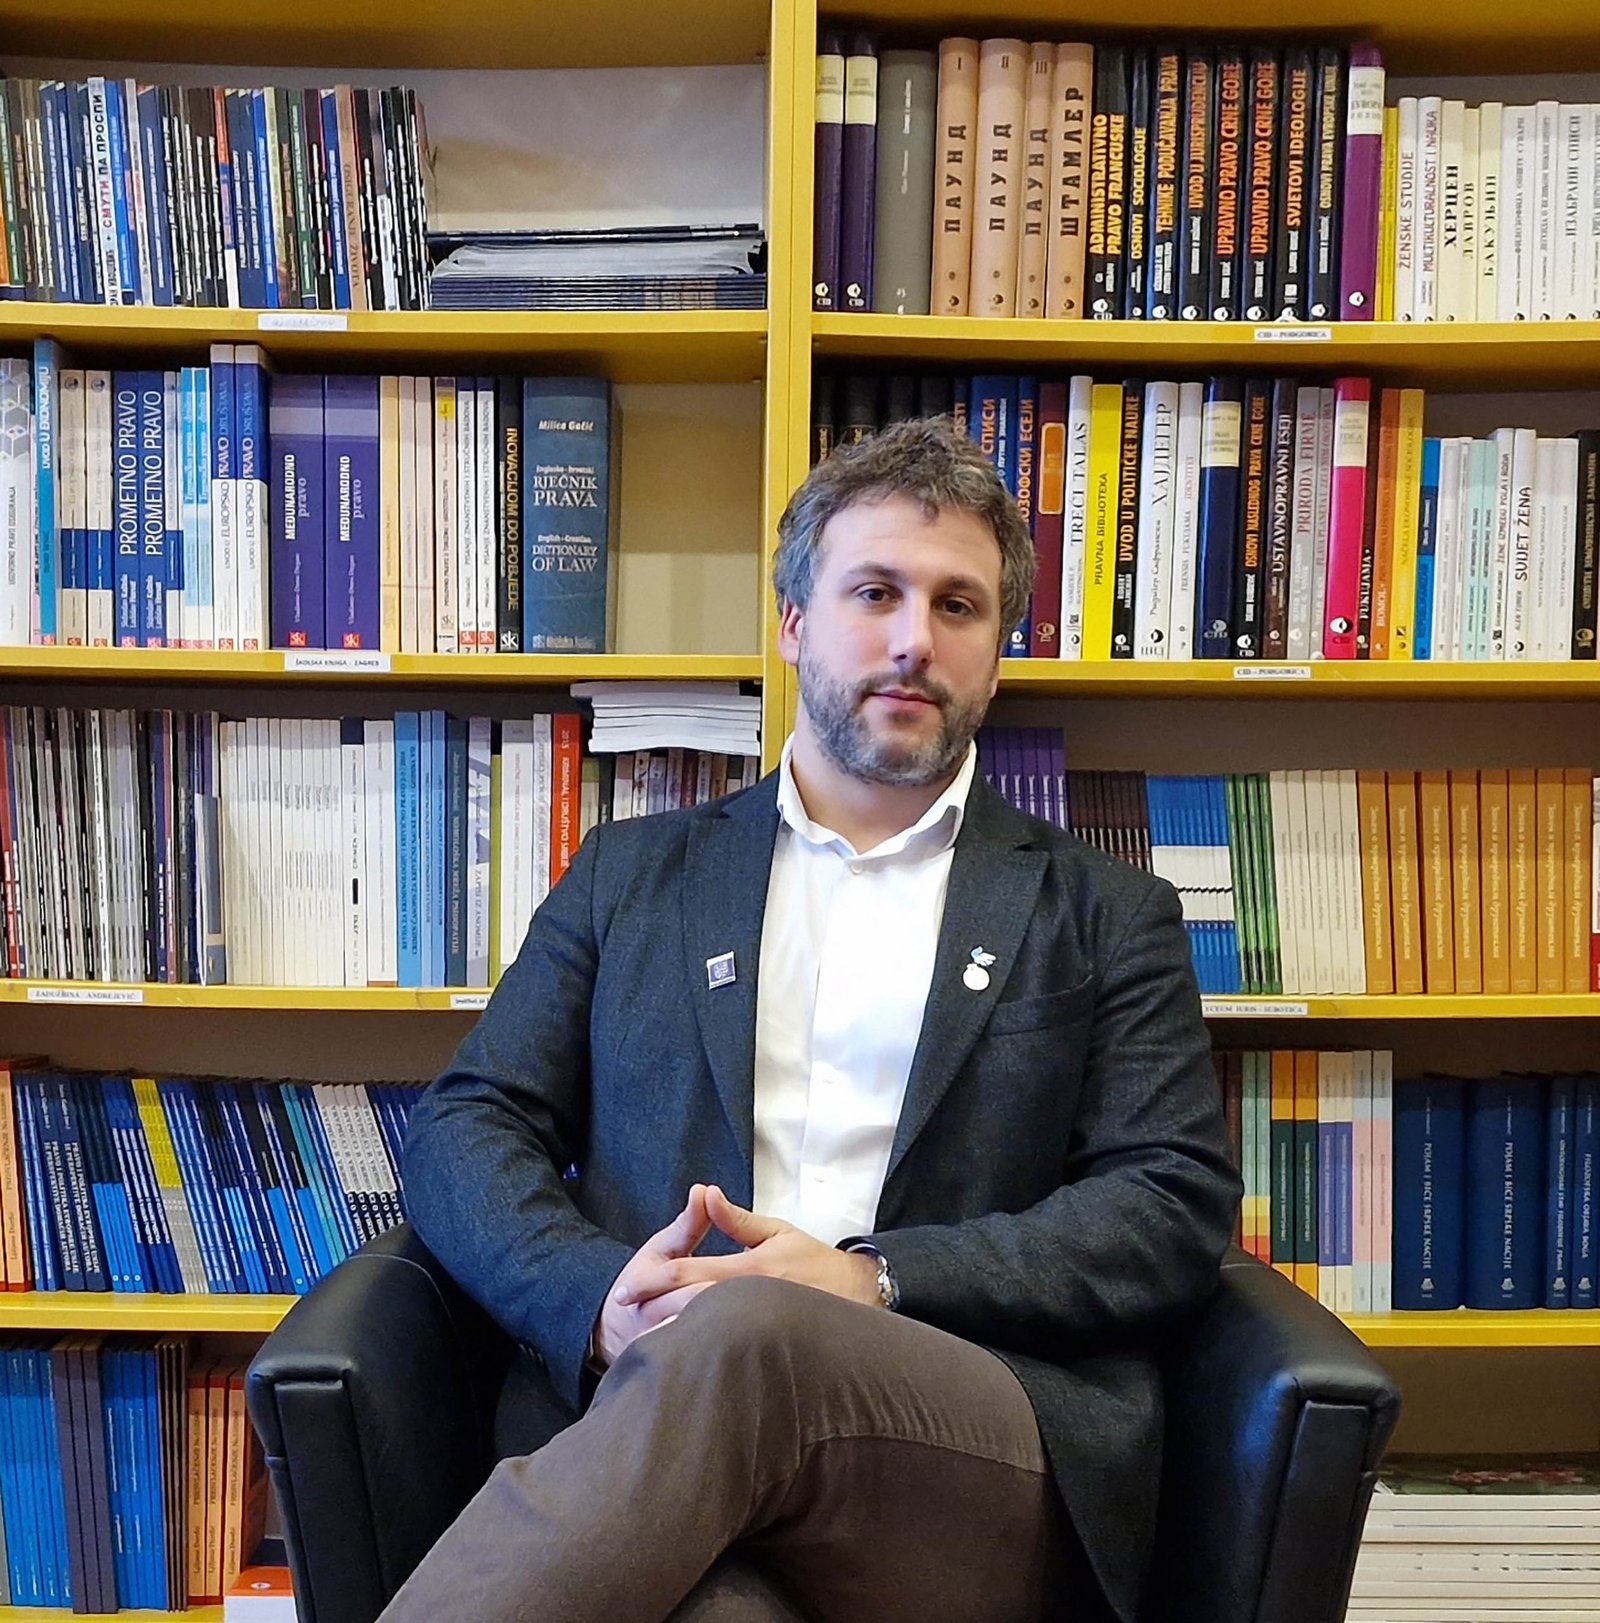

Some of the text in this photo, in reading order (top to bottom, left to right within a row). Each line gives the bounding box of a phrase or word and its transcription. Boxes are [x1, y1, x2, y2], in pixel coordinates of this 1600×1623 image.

[1160, 56, 1178, 92] PRAVA
[1222, 64, 1241, 100] GORE
[1254, 62, 1273, 98] GORE
[93, 95, 106, 152] ПРОСПИ
[1155, 99, 1177, 179] PODUČAVANJA
[1190, 63, 1207, 162] JURISPRUDENCIJU
[1221, 103, 1239, 137] CRNE
[1253, 102, 1272, 137] CRNE
[1289, 69, 1306, 154] IDEOLOGIJE
[1426, 111, 1437, 148] NAUKA
[1567, 115, 1581, 161] СПИСИ
[98, 158, 108, 175] ПА
[945, 124, 966, 233] ПАУНД
[989, 123, 1011, 231] ПАУНД
[1025, 128, 1047, 236] ПАУНД
[1060, 87, 1083, 237] ШТАМЛЕР
[1089, 114, 1108, 255] ADMINISTRATIVNO
[1108, 115, 1124, 254] PRAVO FRANCUSKE
[1190, 164, 1205, 173] U
[1219, 142, 1238, 186] PRAVO
[1252, 141, 1272, 186] PRAVO
[99, 181, 112, 228] СМУТИ
[1131, 127, 1146, 259] OSNOVI SOCIOLOGIJE
[1156, 184, 1174, 233] TEHNIKE
[1189, 176, 1205, 208] UVOD
[1287, 160, 1303, 226] SVJETOVI
[1321, 173, 1333, 208] OSNOVI
[1398, 151, 1414, 269] ŽENSKE STUDIJE
[1423, 160, 1436, 272] MULTIKULTURALNOST
[1444, 166, 1458, 247] ХЕРЦЕН
[1218, 190, 1237, 254] UPRAVNO
[1251, 189, 1270, 254] UPRAVNO
[1463, 182, 1474, 260] ЛАВРОВ
[1484, 175, 1496, 276] БАКУЊИН
[538, 420, 567, 431] Milica
[981, 399, 995, 454] СПИСИ
[1019, 400, 1033, 442] ЕСЕЈИ
[118, 390, 138, 555] PROMETNO PRAVO
[143, 391, 163, 556] PROMETNO PRAVO
[218, 437, 230, 478] PRAVO
[242, 438, 254, 478] PRAVO
[533, 474, 598, 490] RJEČNIK
[1119, 395, 1140, 561] UVOD U POLITIČKE NAUKE
[1151, 403, 1173, 506] ХАЈДЕГЕР
[1248, 449, 1262, 475] PRAVA
[1297, 413, 1315, 533] PRIRODA FIRME
[220, 481, 230, 538] EUROPSKO
[244, 482, 255, 538] EUROPSKO
[298, 478, 309, 517] pravo
[352, 479, 364, 519] pravo
[533, 490, 597, 507] PRAVA
[1070, 422, 1087, 547] TREĆI TALAS
[1272, 414, 1291, 572] USTAVNOPRAVNI ESEJI
[1513, 487, 1531, 527] ŽENA
[8, 528, 16, 549] PRAVO
[506, 427, 519, 611] INOVACIJOM DO POBJEDE
[1094, 473, 1108, 585] PRAVNA BIBLIOTEKA
[532, 544, 597, 557] DICTIONARY
[532, 557, 597, 572] OF LAW
[1245, 534, 1259, 567] OSNOVI
[1360, 555, 1372, 619] FUKUJAMA
[1423, 1204, 1432, 1235] SRPSKE
[1504, 1204, 1512, 1235] SRPSKE
